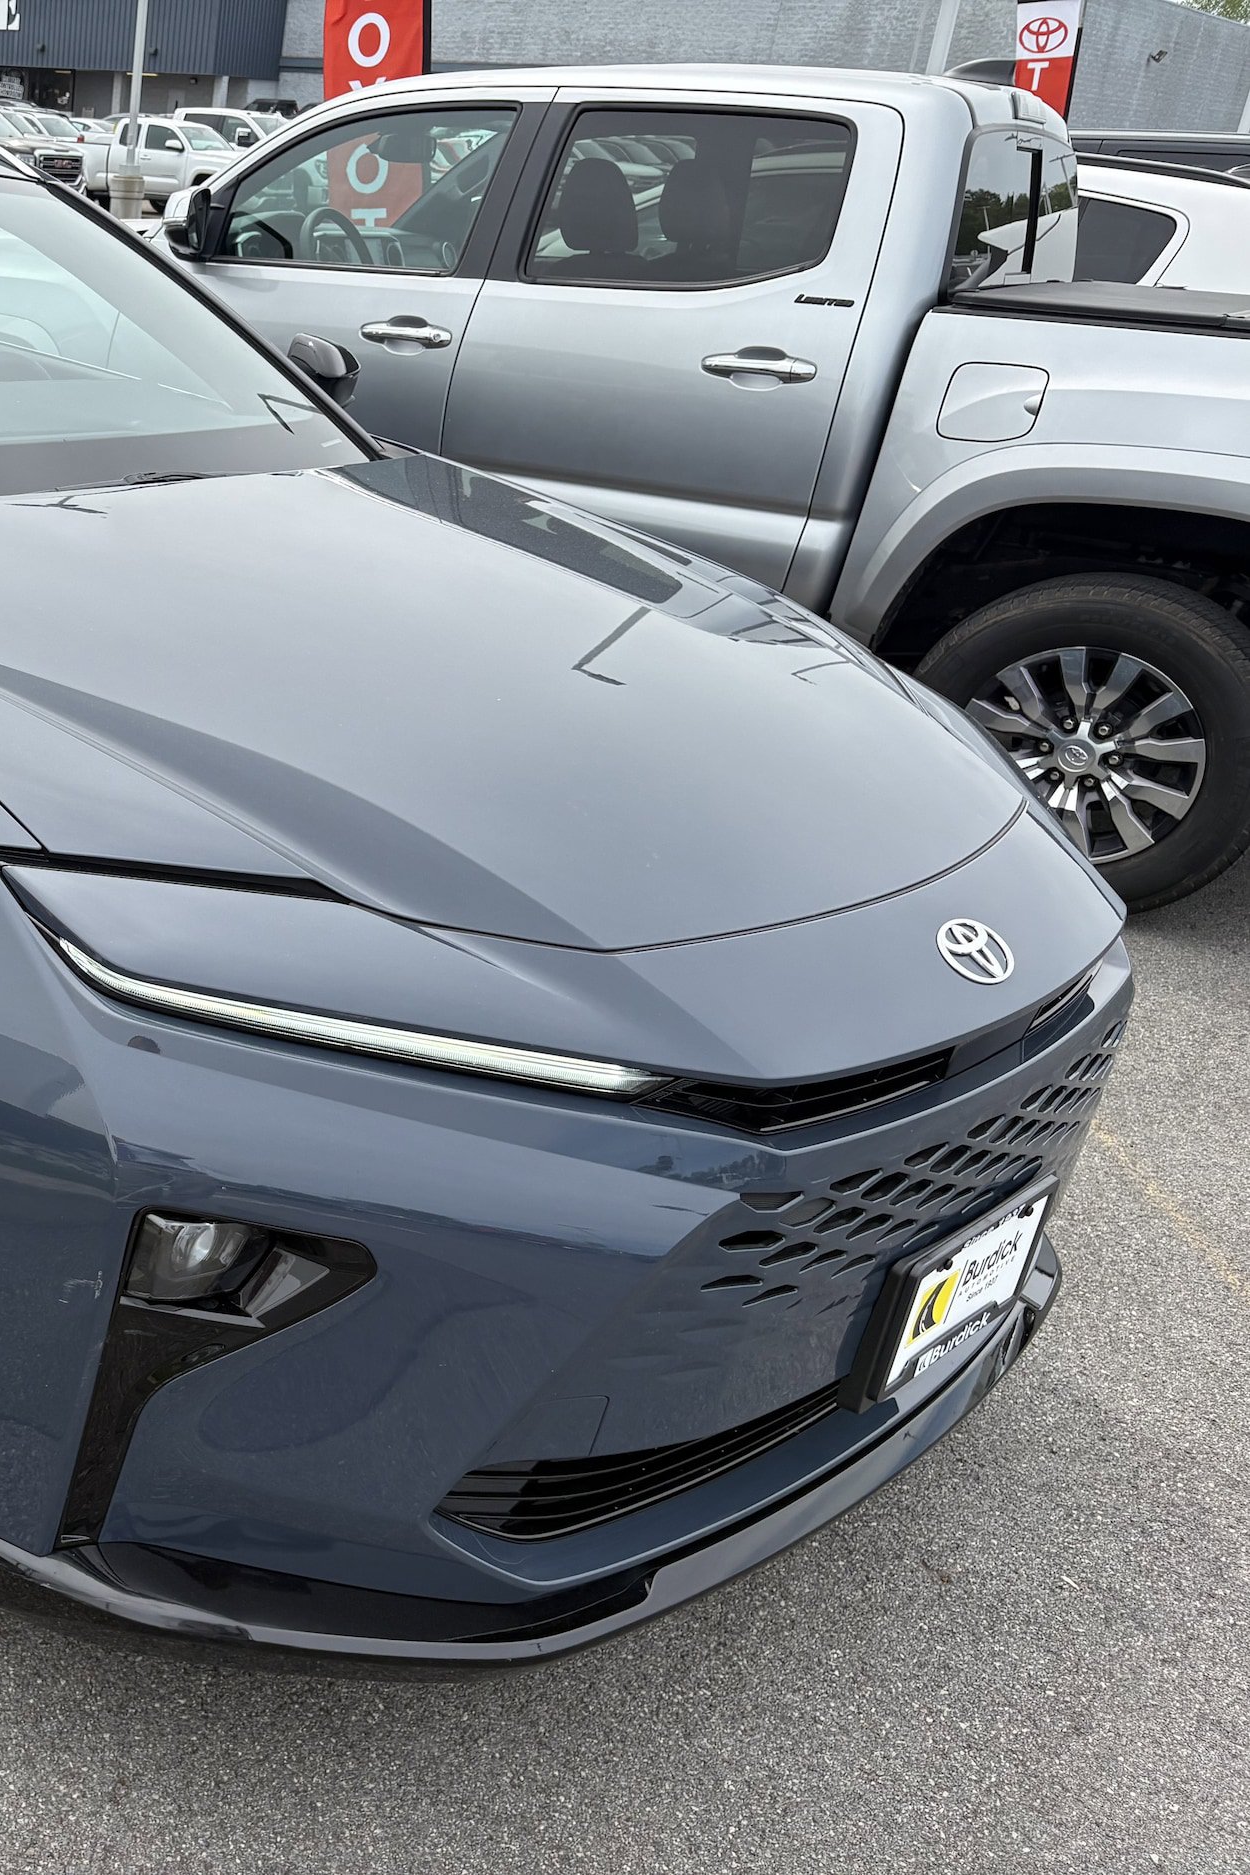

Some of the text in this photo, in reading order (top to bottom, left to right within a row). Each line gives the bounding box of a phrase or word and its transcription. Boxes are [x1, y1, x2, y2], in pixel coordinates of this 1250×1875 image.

[958, 1255, 1015, 1297] AUTOMOTIVE
[962, 1230, 1024, 1287] Burdick
[966, 1286, 983, 1302] Since
[930, 1312, 990, 1364] Burdick
